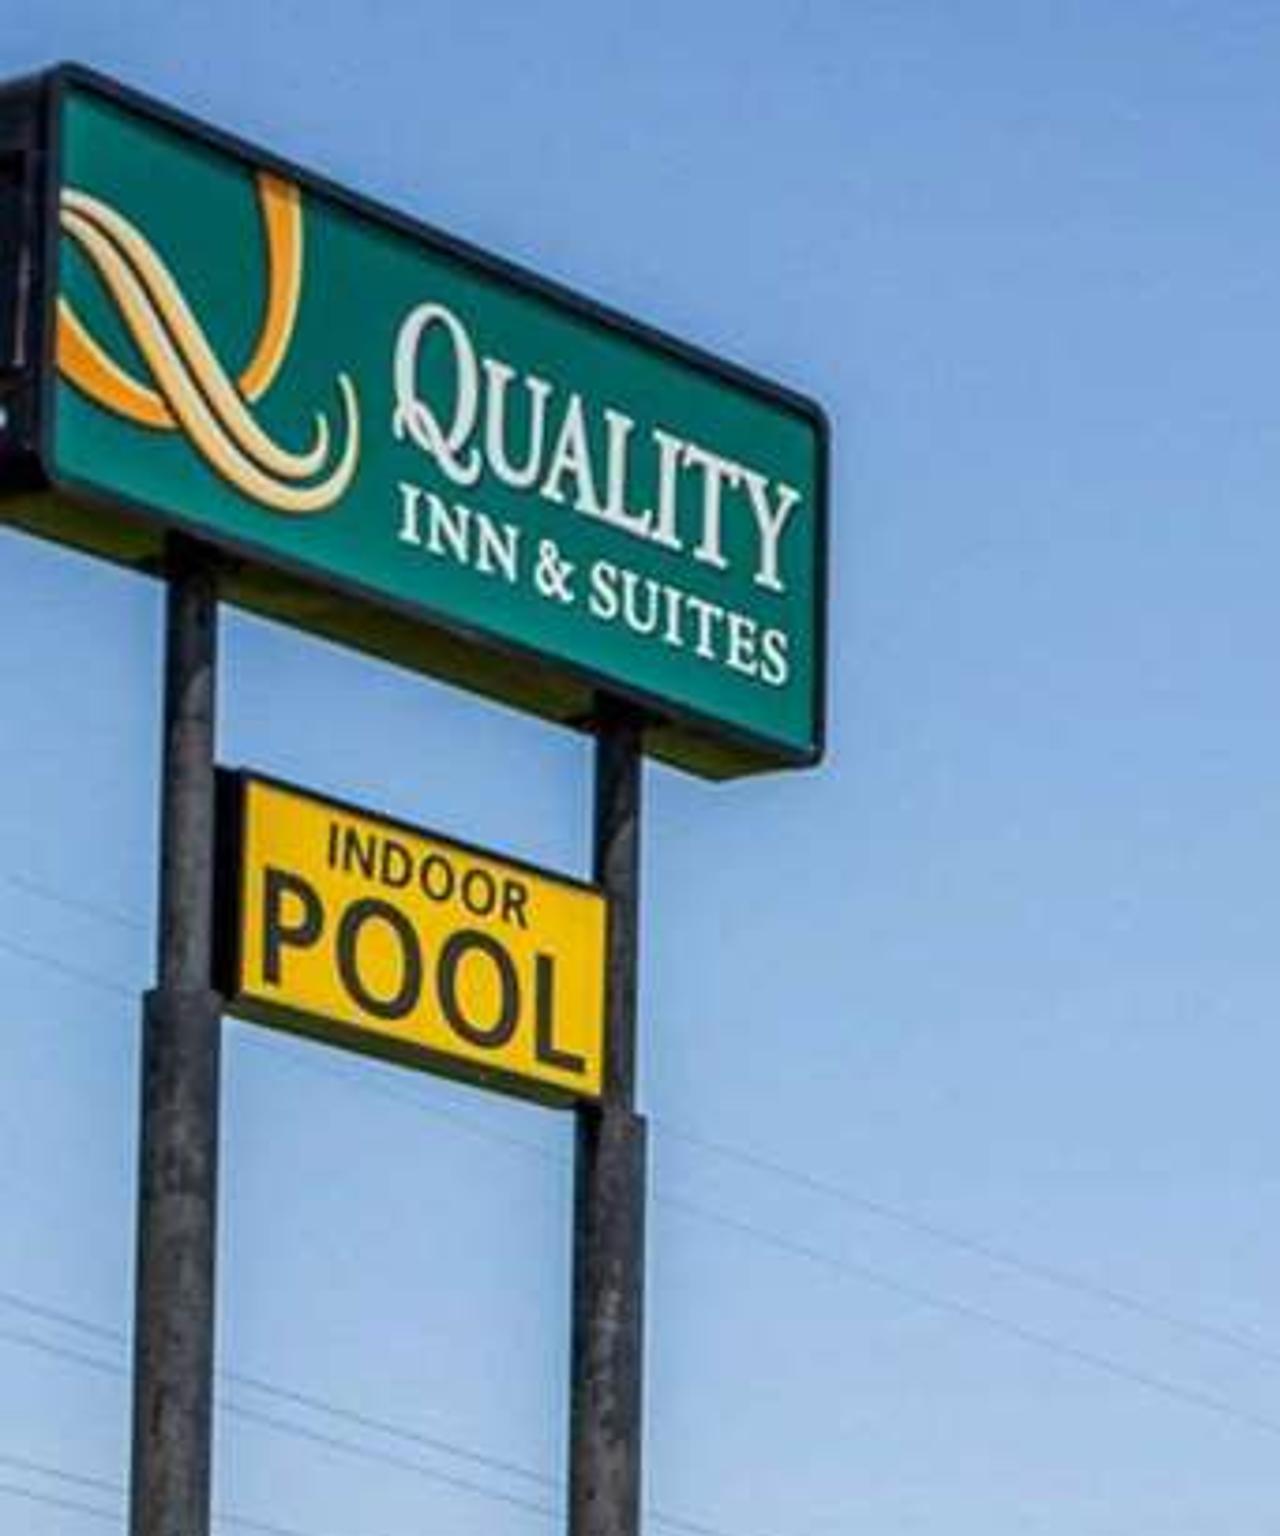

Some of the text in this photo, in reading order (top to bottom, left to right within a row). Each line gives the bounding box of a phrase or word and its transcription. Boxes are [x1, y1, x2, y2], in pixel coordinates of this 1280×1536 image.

[394, 302, 803, 592] QUALITY
[398, 482, 790, 687] INN & SUITES
[262, 863, 586, 1074] POOL
[328, 822, 529, 930] INDOOR
